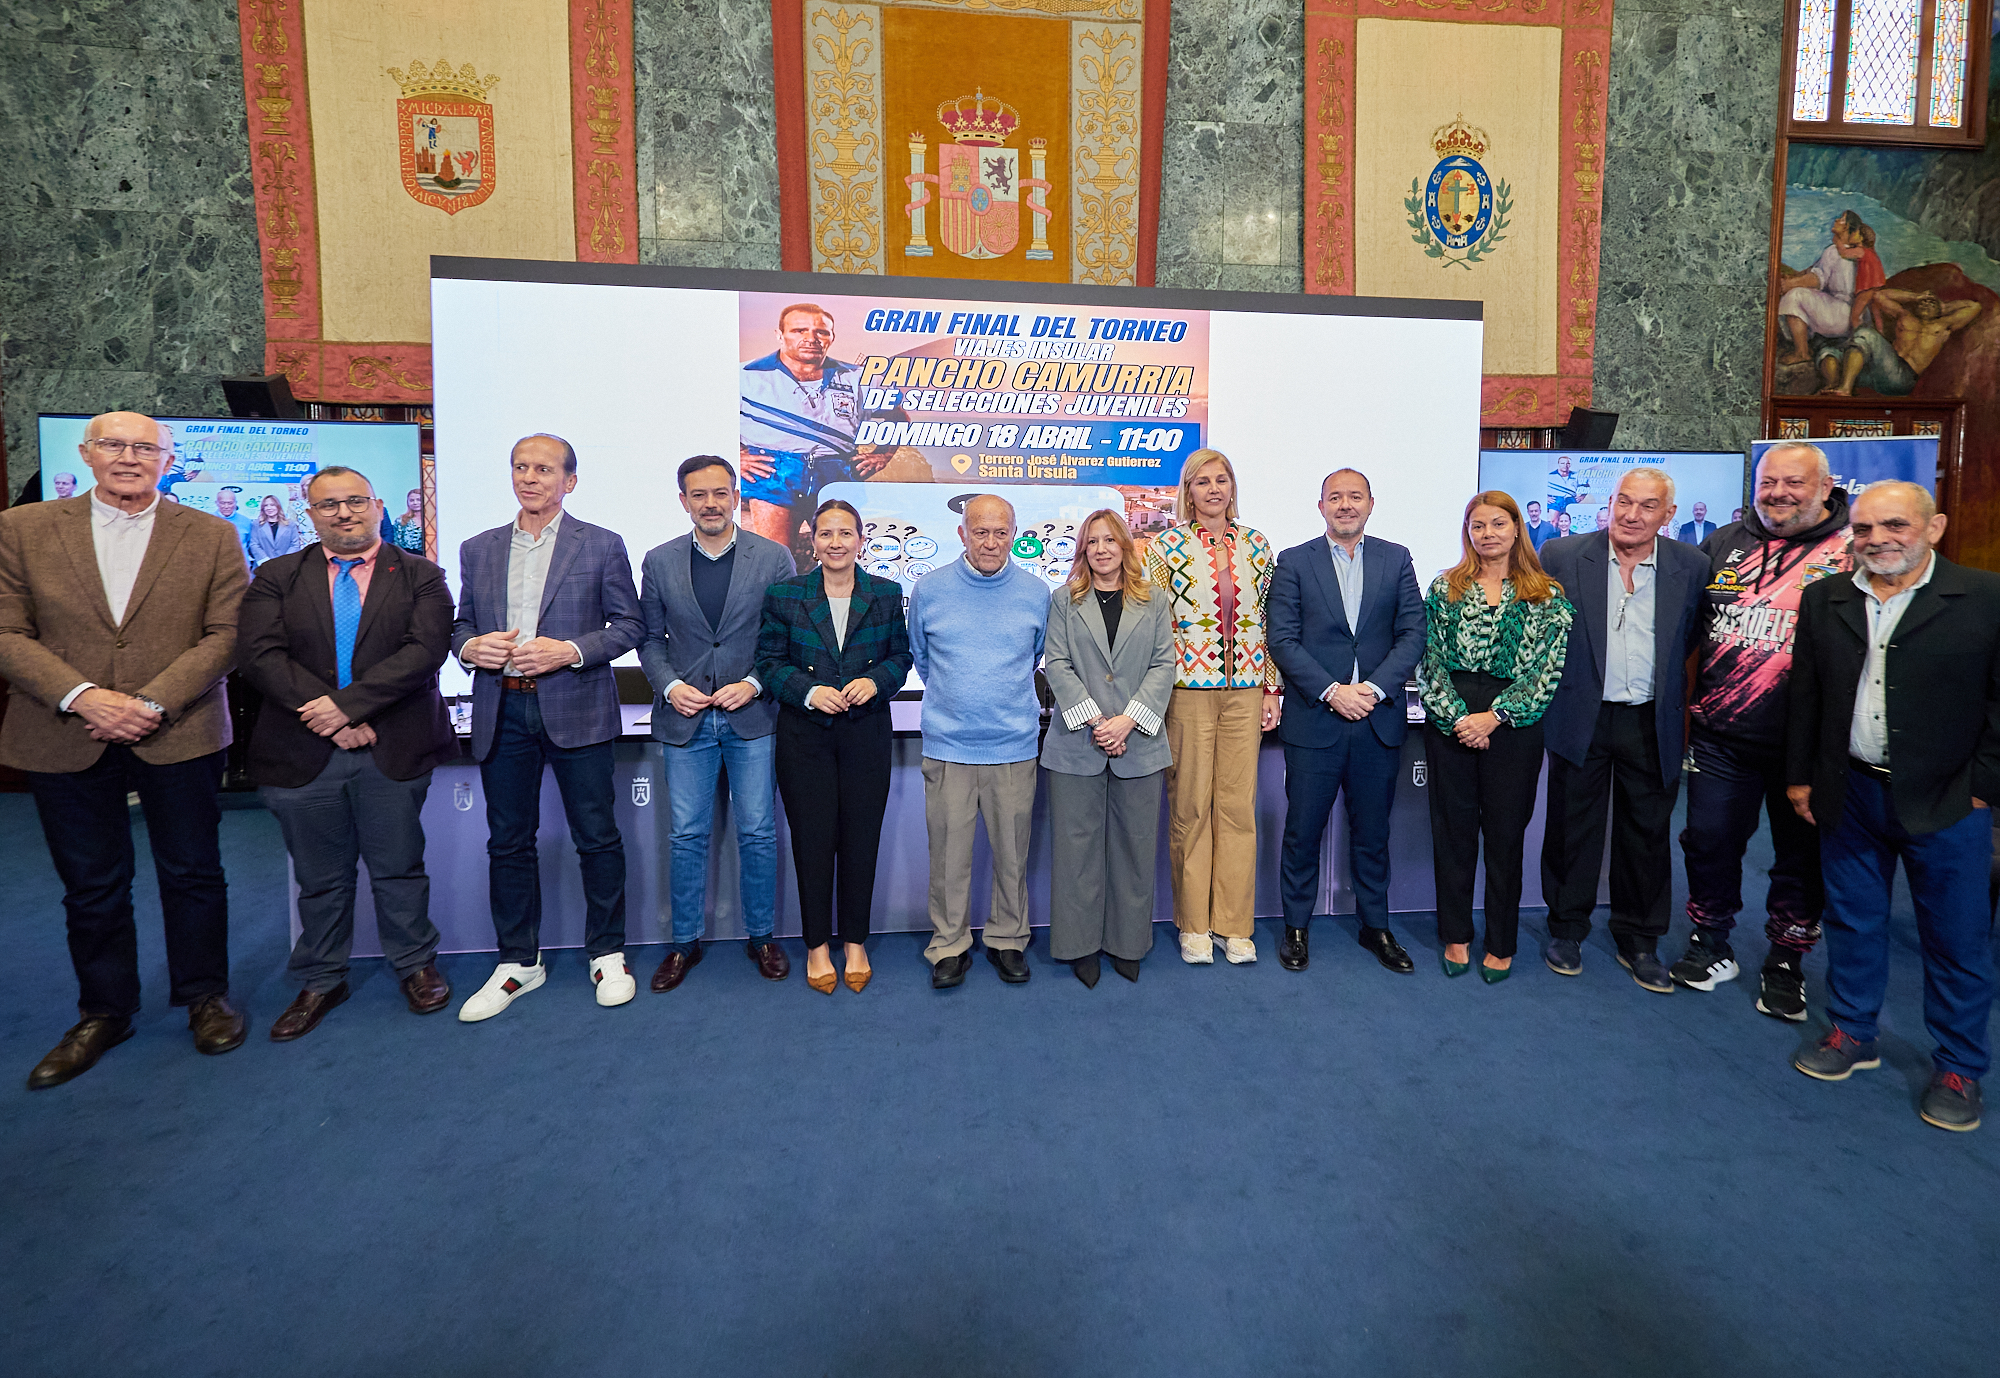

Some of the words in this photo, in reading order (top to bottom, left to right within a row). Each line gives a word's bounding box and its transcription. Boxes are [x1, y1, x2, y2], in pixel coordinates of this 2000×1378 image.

[864, 308, 942, 334] GRAN
[946, 312, 1021, 337] FINAL
[1029, 315, 1077, 339] DEL
[1088, 317, 1188, 343] TORNEO
[953, 337, 1027, 359] VIAJES
[1028, 340, 1116, 362] INSULAR
[859, 355, 1007, 391] PANCHO
[1011, 360, 1195, 396] CAMURRIA
[862, 387, 901, 411] DE
[901, 389, 1062, 415] SELECCIONES
[1064, 393, 1191, 419] JUVENILES
[185, 425, 215, 433] GRAN
[217, 426, 245, 434] FINAL
[248, 426, 267, 434] DEL
[271, 427, 309, 435] TORNEO
[853, 420, 984, 448] DOMINGO
[986, 423, 1020, 449] 18
[1019, 424, 1094, 451] ABRIL
[1117, 426, 1184, 452] 11:00
[185, 440, 240, 452] PANCHO
[243, 442, 313, 453] CAMURRIA
[184, 461, 232, 471] DOMINGO
[235, 463, 245, 471] 18
[247, 463, 275, 472] ABRIL
[284, 463, 310, 472] 11:00
[978, 453, 1024, 465] Terrero
[1026, 453, 1057, 466] José
[1060, 453, 1105, 467] Álvarez
[1106, 455, 1162, 468] Gutierrez
[1579, 456, 1599, 464] GRAN
[1600, 456, 1621, 464] FINAL
[978, 464, 1024, 478] Santa
[1578, 469, 1615, 478] PANCHO
